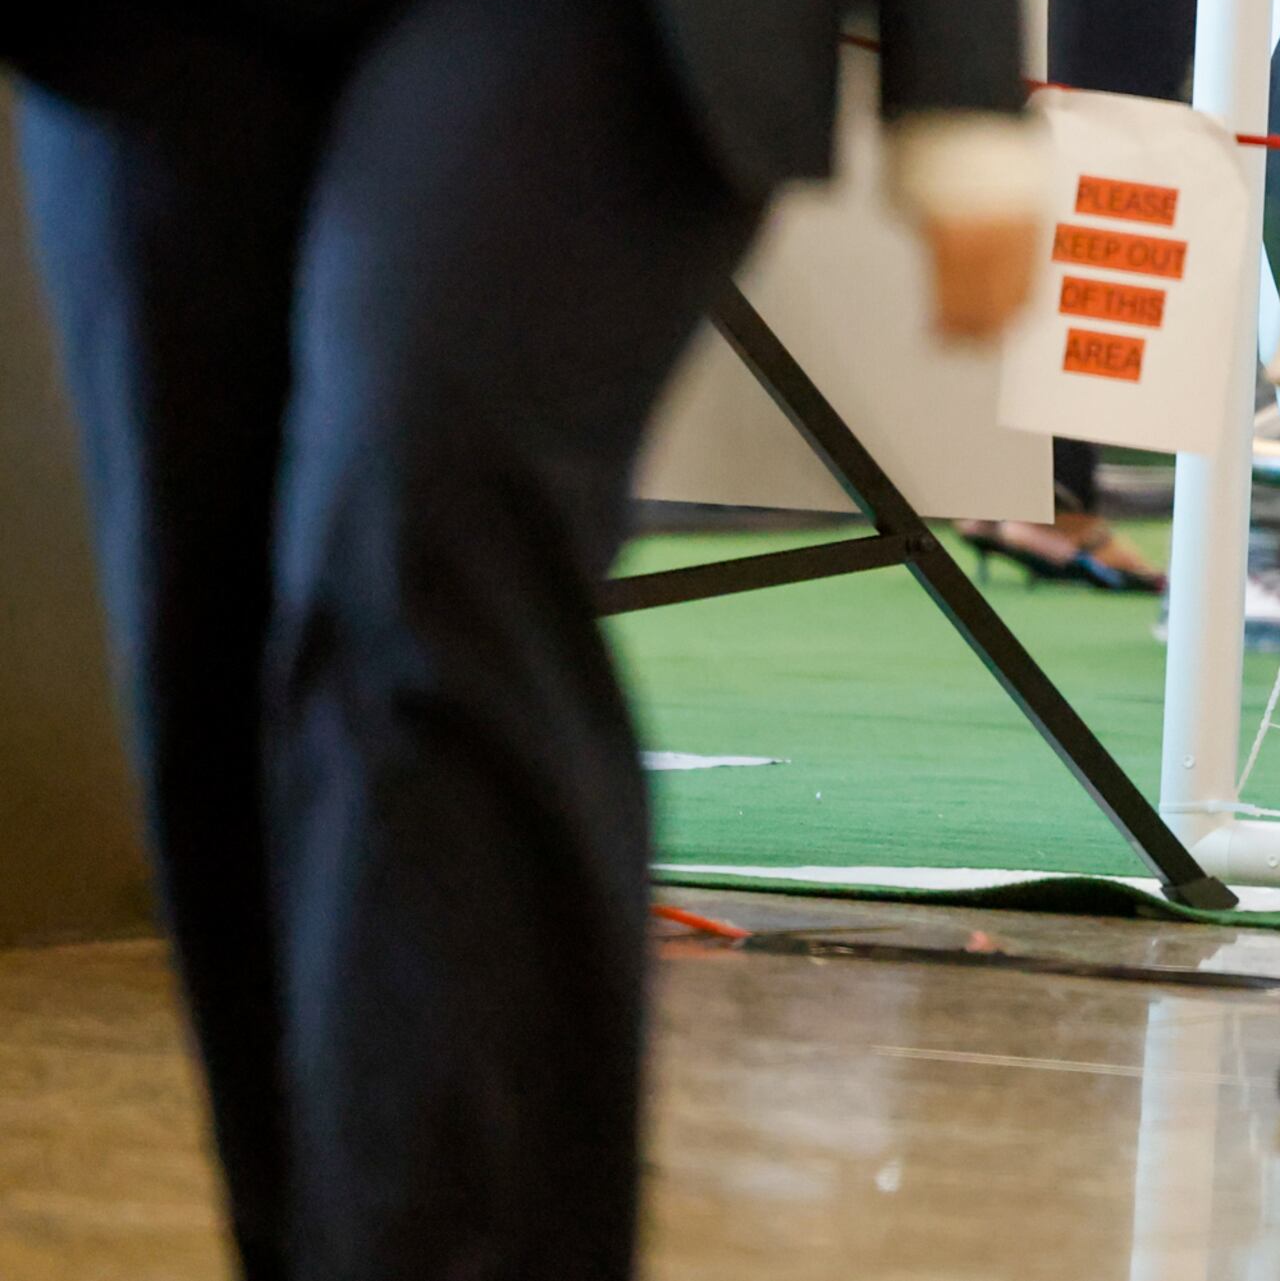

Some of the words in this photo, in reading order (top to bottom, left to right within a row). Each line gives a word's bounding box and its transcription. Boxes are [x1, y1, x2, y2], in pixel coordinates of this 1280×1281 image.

[1076, 181, 1176, 221] PLEASE
[1053, 232, 1121, 264] KEEP
[1126, 241, 1186, 276] OUT
[1061, 282, 1097, 311] OF
[1103, 289, 1164, 324] THIS
[1066, 337, 1142, 372] AREA
